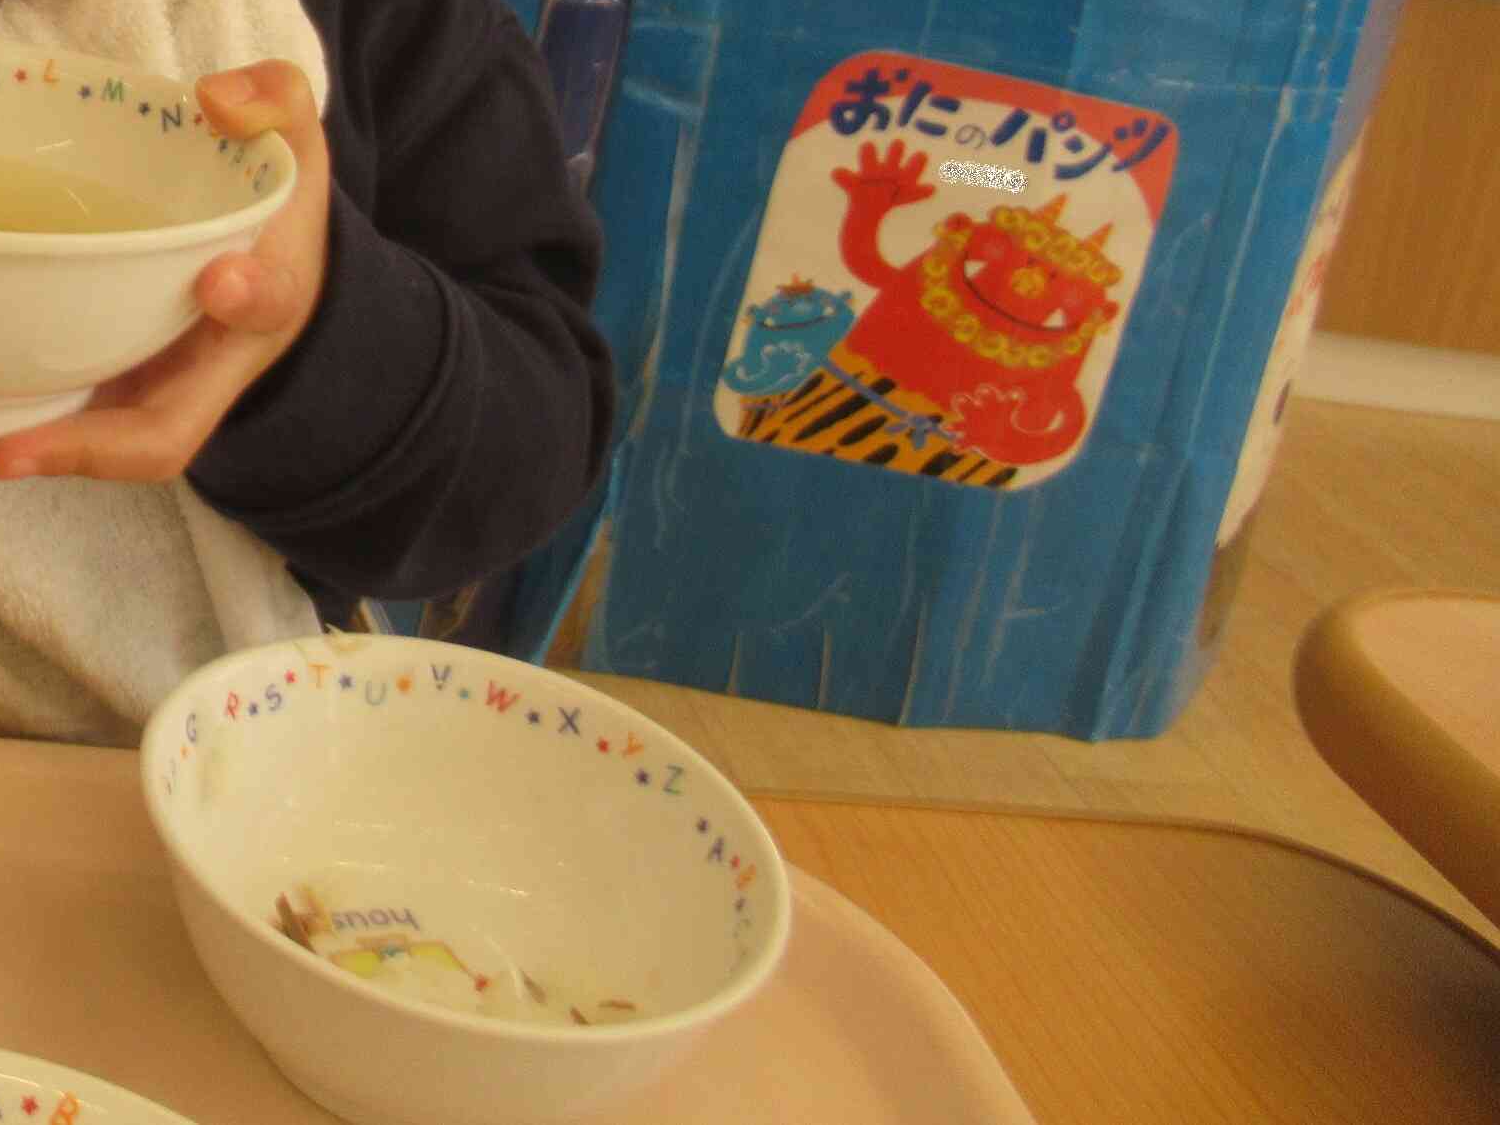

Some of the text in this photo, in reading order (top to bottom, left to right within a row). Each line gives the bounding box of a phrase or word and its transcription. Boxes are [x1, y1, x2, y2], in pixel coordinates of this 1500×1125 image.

[42, 59, 59, 84] L
[102, 78, 125, 102] M
[161, 103, 182, 132] N
[830, 69, 1171, 179] おにのパンツ
[225, 691, 240, 719] R
[264, 683, 283, 712] S
[307, 664, 331, 689] T
[365, 680, 387, 706] U
[431, 664, 451, 690] V
[486, 680, 520, 713] W
[558, 707, 580, 734] X
[622, 731, 644, 757] Y
[663, 765, 684, 794] Z
